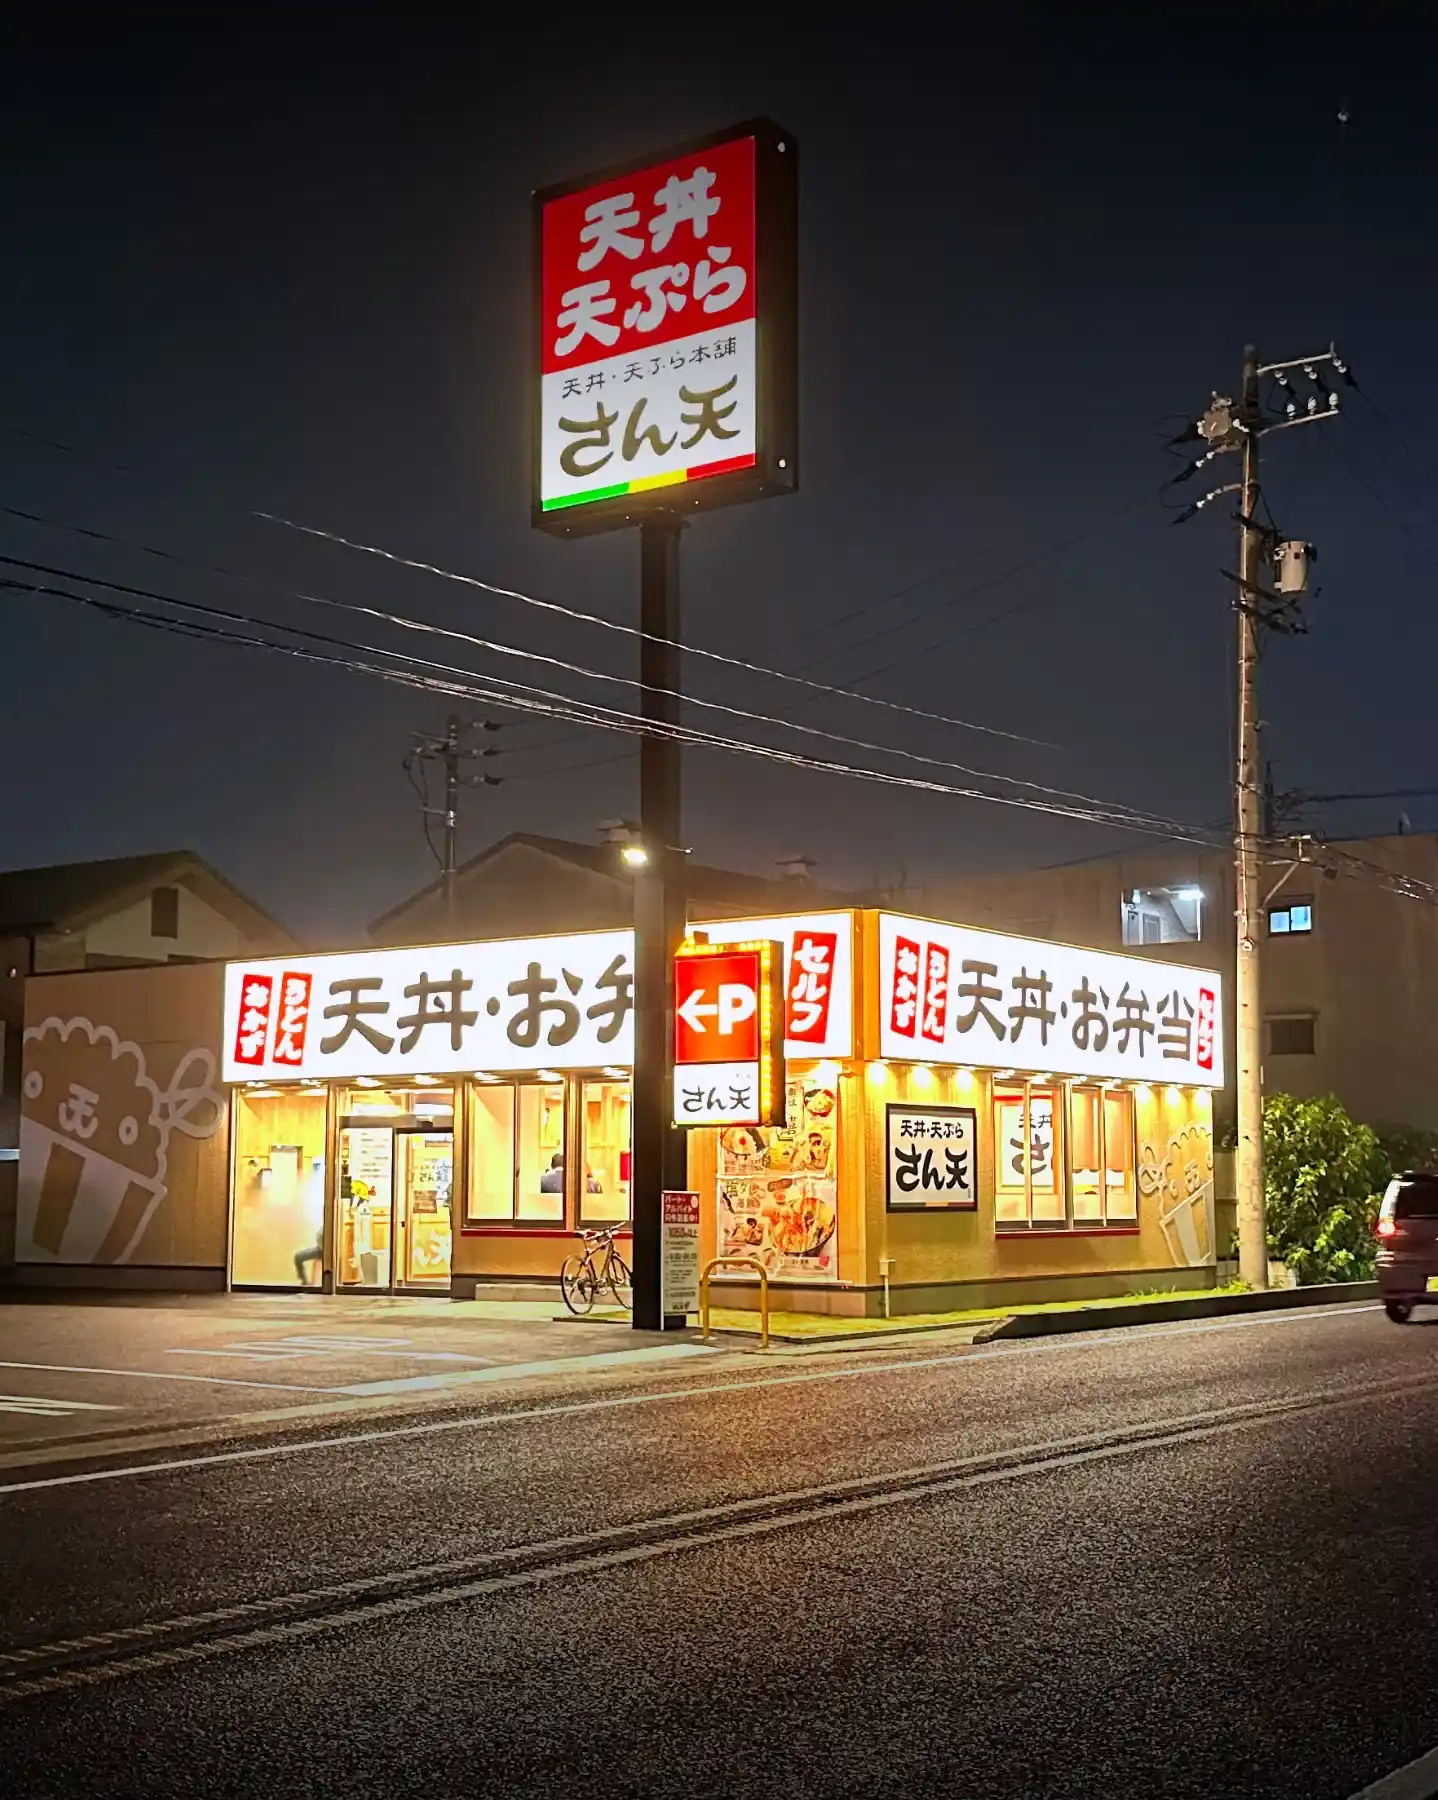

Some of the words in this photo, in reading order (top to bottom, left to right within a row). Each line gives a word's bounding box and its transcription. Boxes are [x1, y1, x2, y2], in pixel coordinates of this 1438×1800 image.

[577, 166, 721, 272] 天丼
[553, 245, 747, 357] 天ぷら
[558, 374, 741, 477] さん天
[239, 982, 270, 1058] おかず
[275, 978, 308, 1060] うどん
[718, 983, 758, 1035] P
[789, 938, 830, 1033] セルフ
[894, 945, 918, 1028] おかず
[923, 950, 948, 1037] うどん
[956, 959, 1195, 1062] 天丼・お弁当
[682, 1085, 751, 1113] さん天
[900, 1119, 964, 1139] 天丼・天ぷら
[895, 1143, 969, 1192] さん天
[1010, 1134, 1053, 1175] さ
